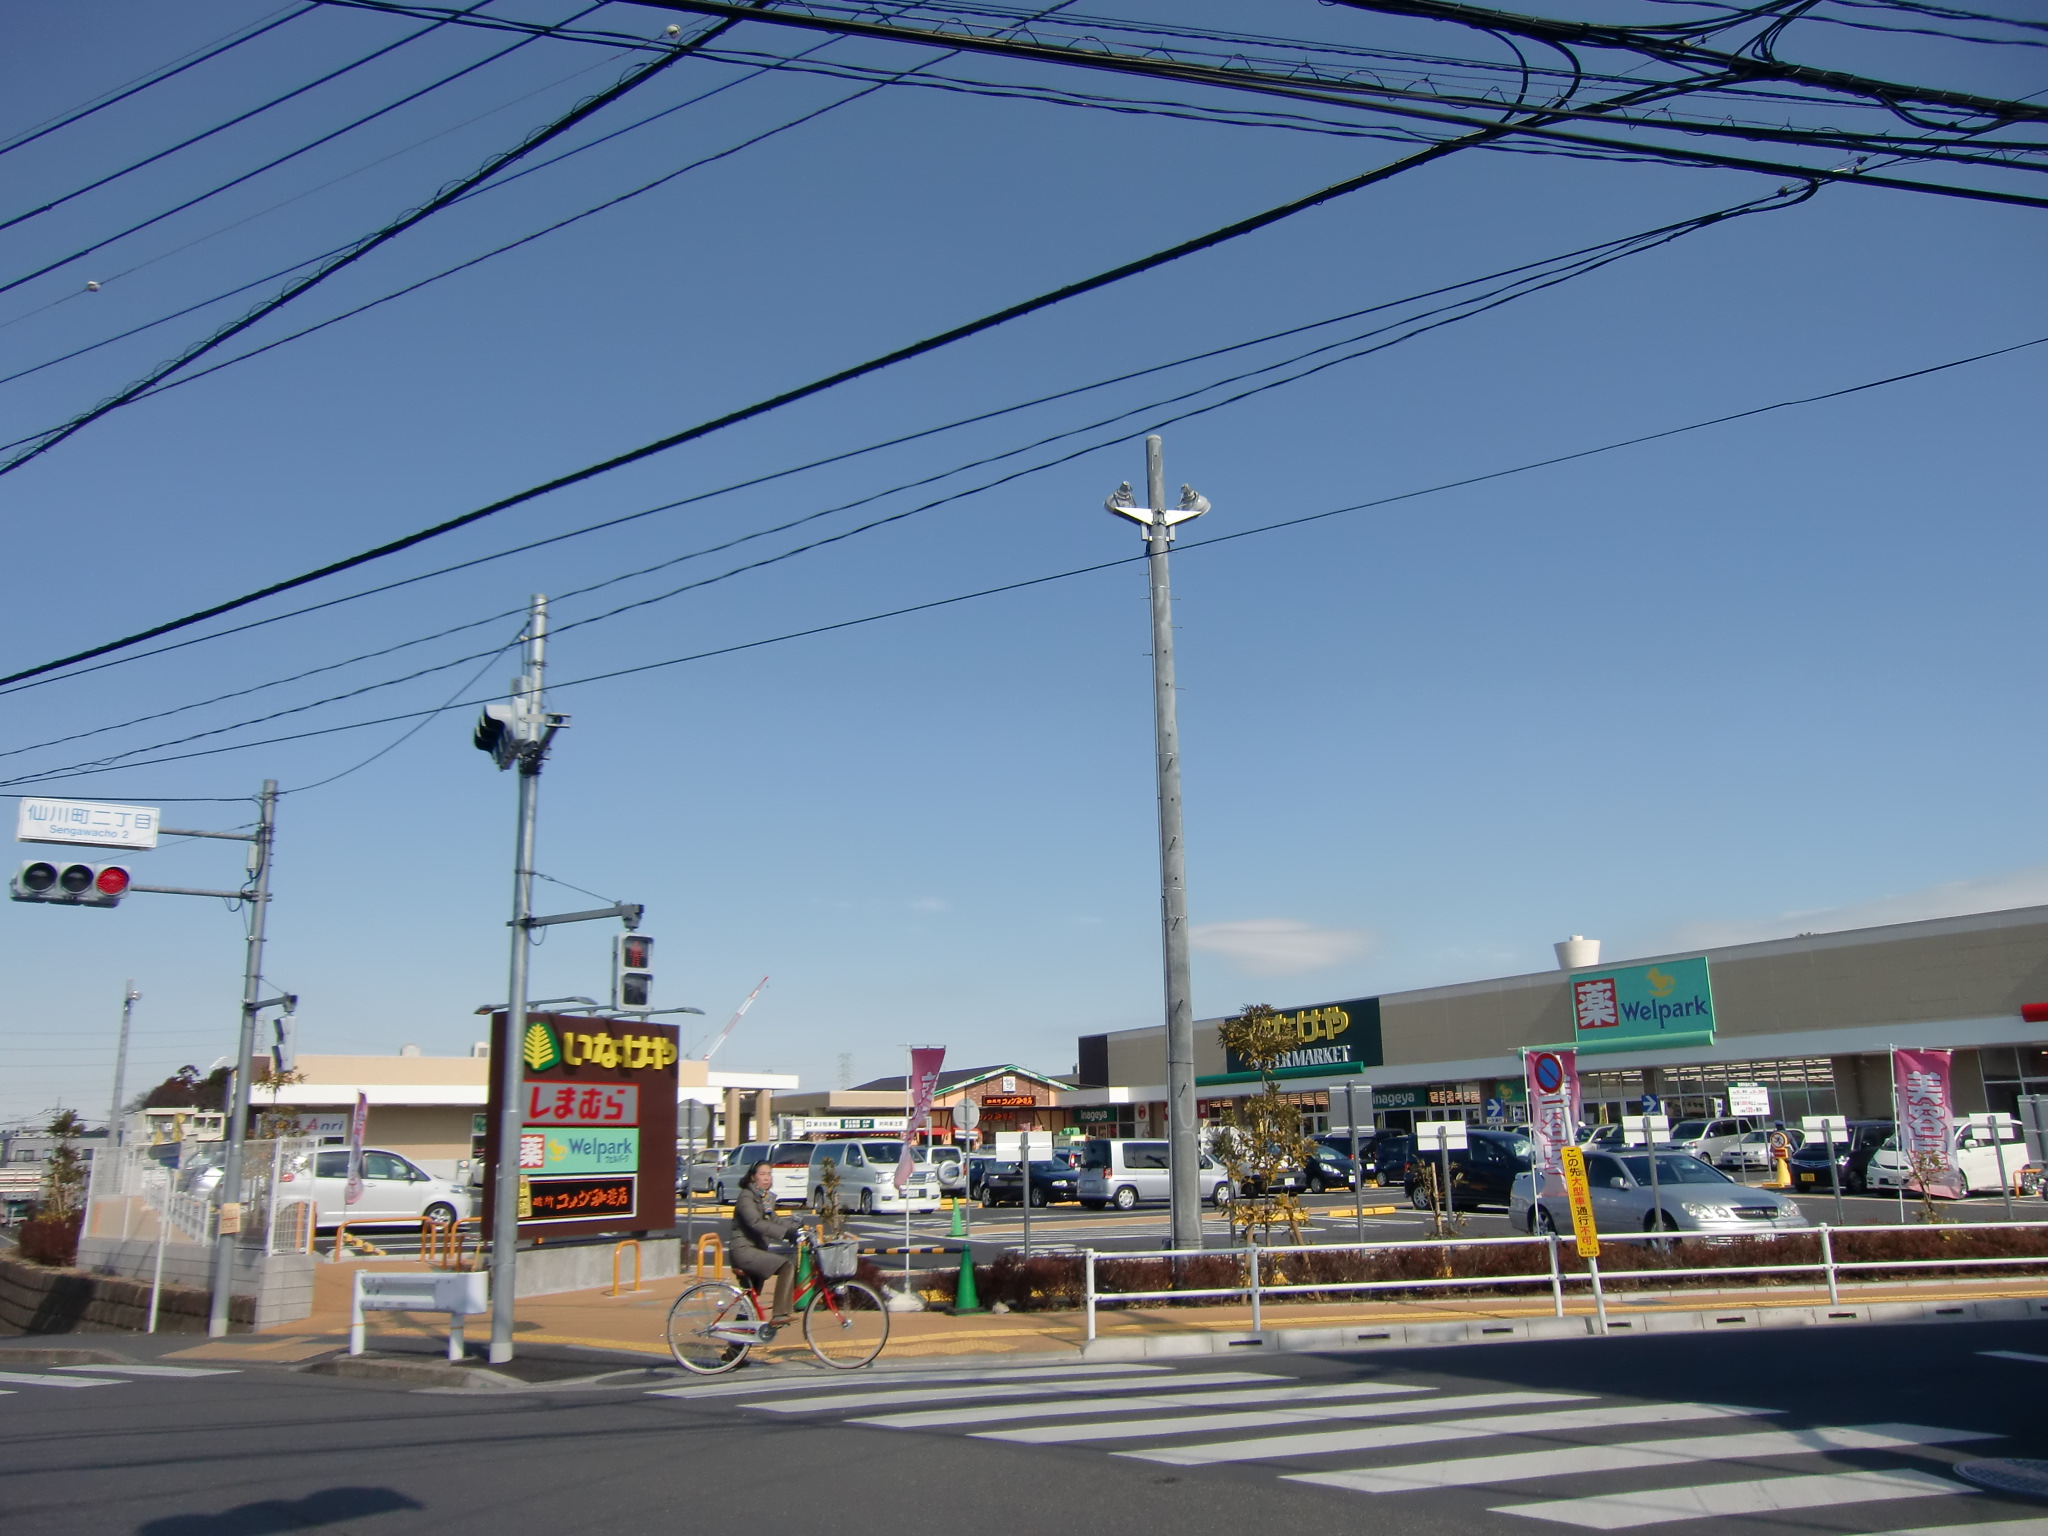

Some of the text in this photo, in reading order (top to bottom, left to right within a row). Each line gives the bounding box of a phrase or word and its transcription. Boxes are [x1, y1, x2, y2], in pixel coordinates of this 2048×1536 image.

[27, 804, 152, 830] 仙川町二丁目
[49, 824, 129, 839] Sengawacho 2
[1577, 980, 1616, 1027] 薬
[1621, 995, 1709, 1029] Welpark
[563, 1031, 677, 1070] いなけや
[529, 1086, 626, 1120] しまむら
[1080, 1109, 1107, 1122] inageya
[305, 1117, 344, 1131] Anri
[519, 1136, 543, 1166] 薬
[568, 1138, 632, 1163] Welpark
[1566, 1149, 1593, 1246] この先大型車通行不可
